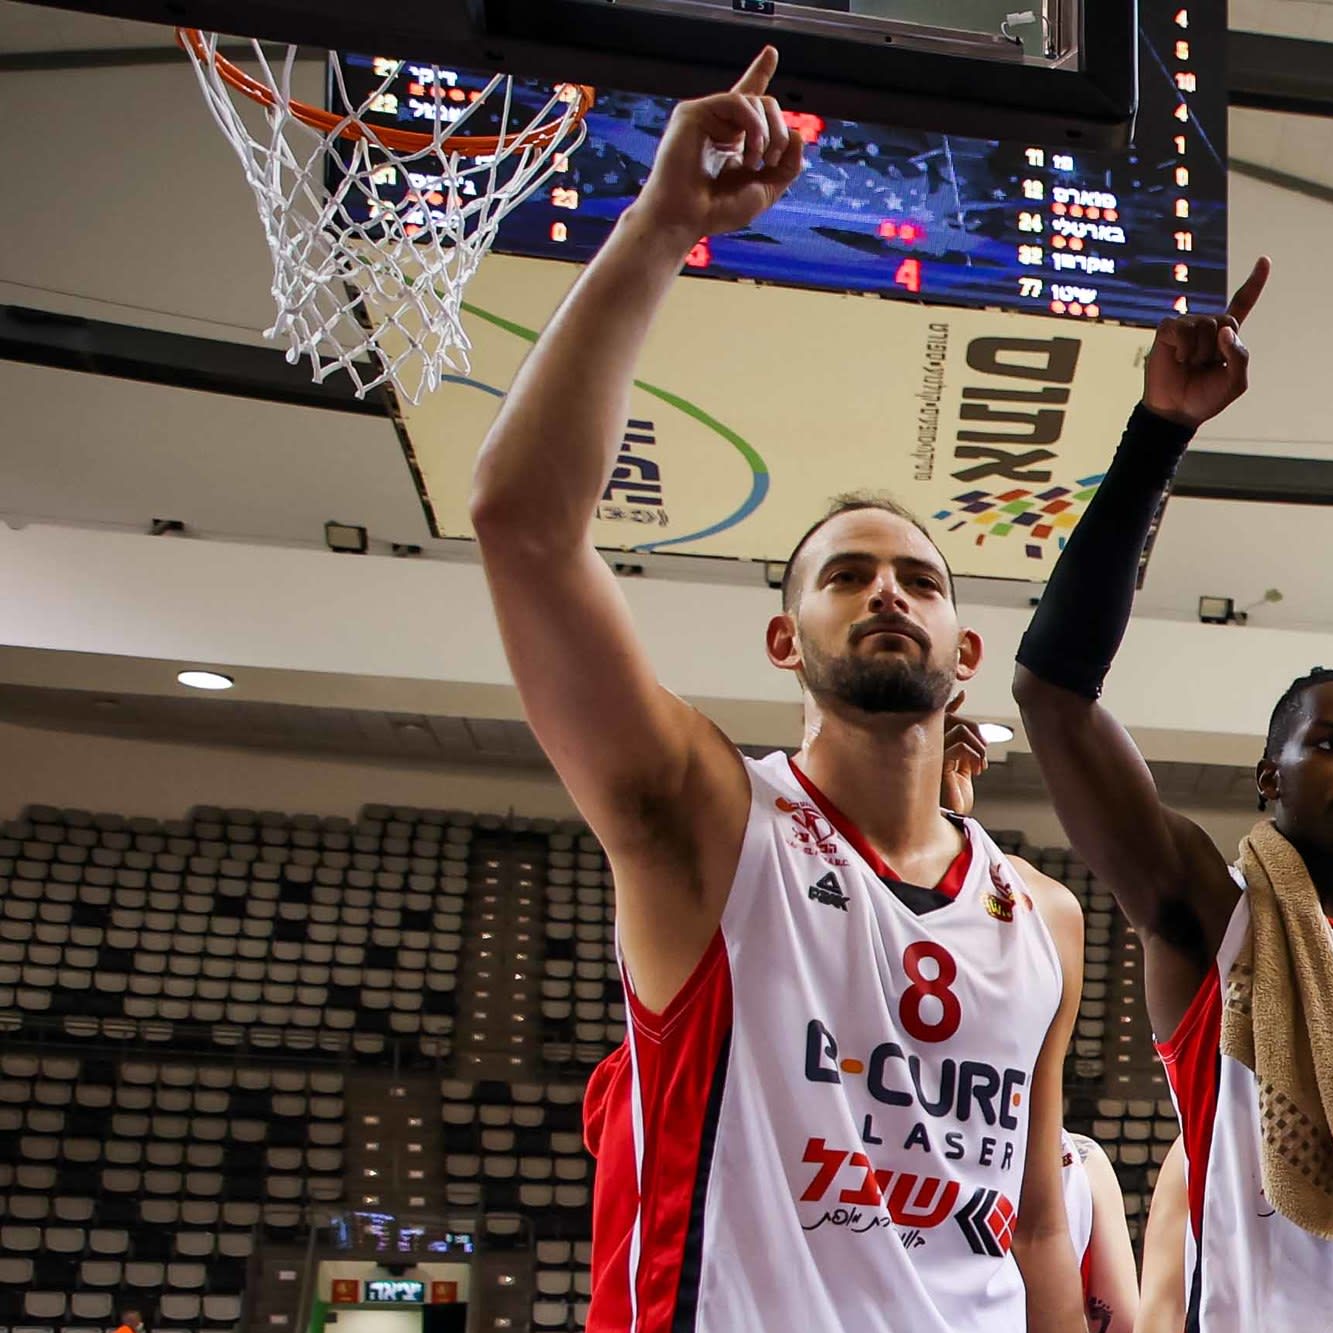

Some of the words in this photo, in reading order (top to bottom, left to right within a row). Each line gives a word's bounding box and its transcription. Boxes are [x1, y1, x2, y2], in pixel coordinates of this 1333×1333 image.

[1174, 231, 1193, 252] 11
[896, 258, 921, 292] 4
[1018, 276, 1042, 298] 77
[1173, 296, 1188, 315] 4
[899, 941, 962, 1043] 8
[805, 1019, 1026, 1132] B-CURE
[863, 1114, 1013, 1171] LASER
[368, 1281, 423, 1301] יציאה
